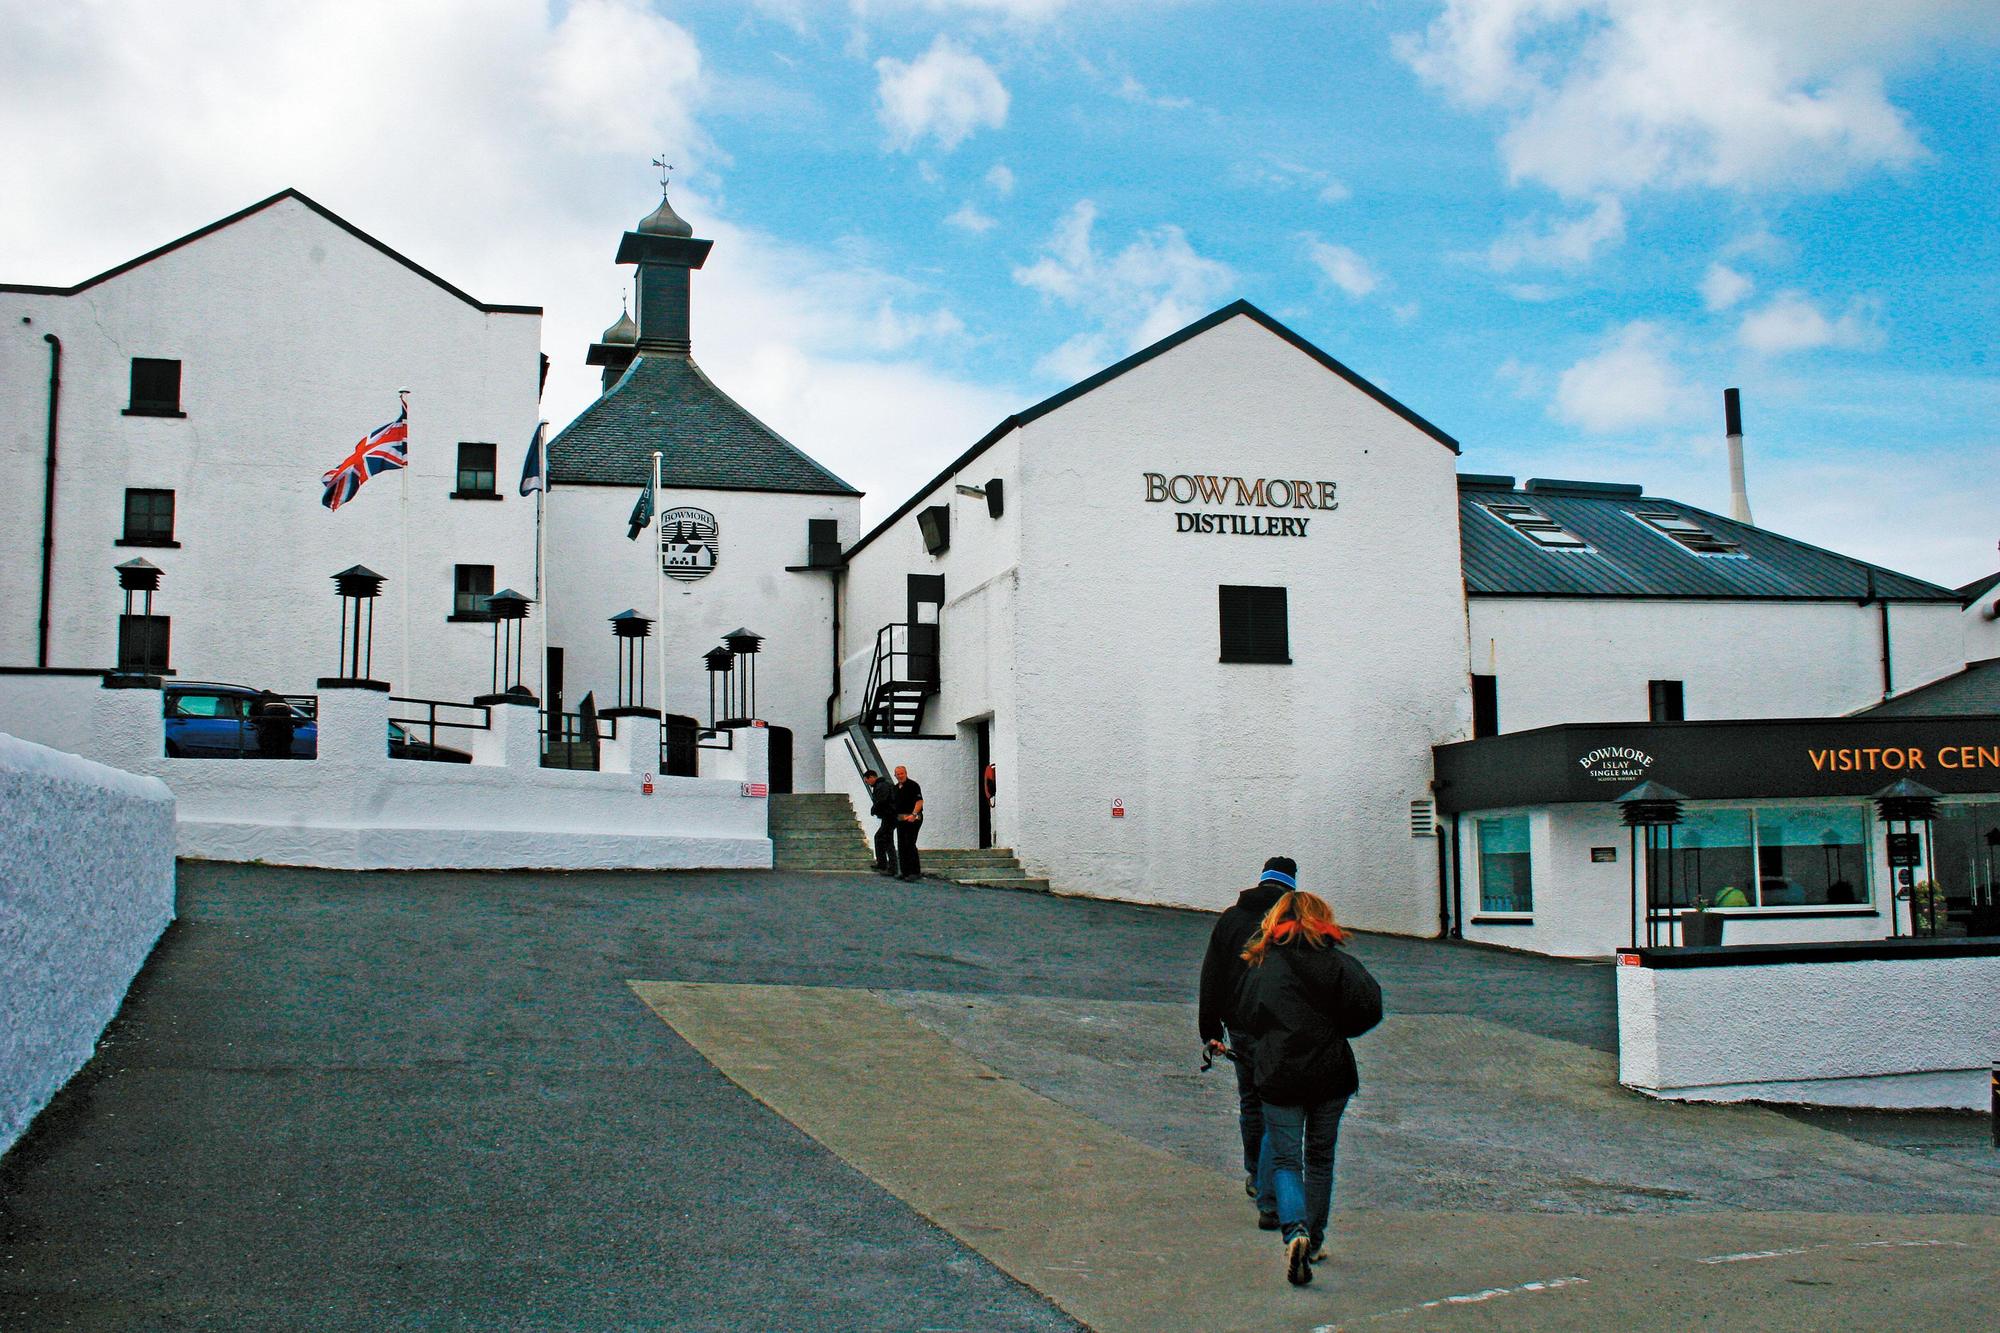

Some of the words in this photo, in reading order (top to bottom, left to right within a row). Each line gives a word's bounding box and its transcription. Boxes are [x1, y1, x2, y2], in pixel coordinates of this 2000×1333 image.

[1143, 473, 1338, 510] BOWMORE
[664, 511, 712, 524] BOWMORE
[1175, 512, 1310, 537] DISTILLERY
[1579, 746, 1654, 768] BOWMORE
[1602, 761, 1630, 769] ISLAY
[1808, 748, 1926, 771] VISITOR
